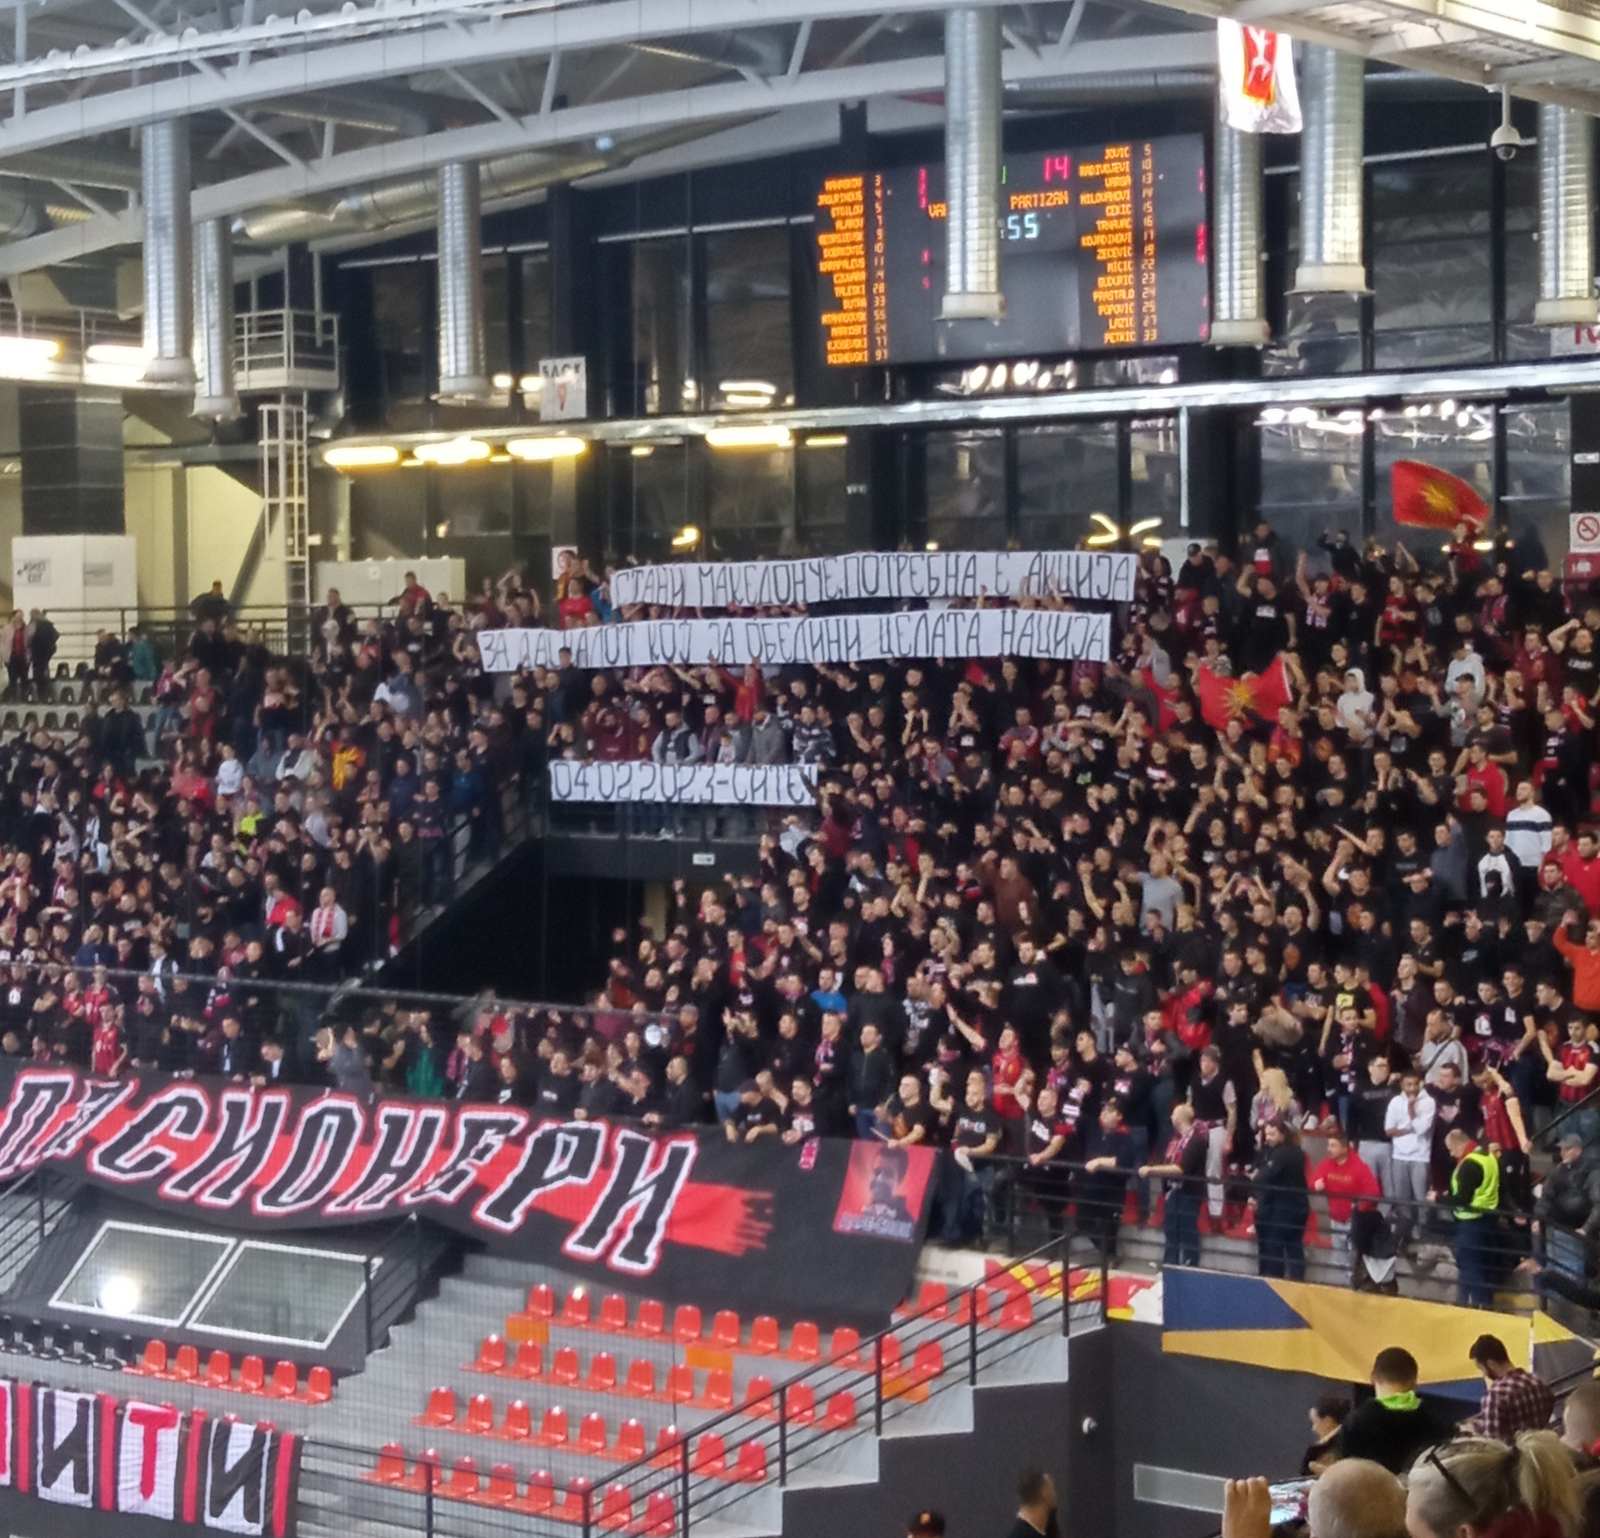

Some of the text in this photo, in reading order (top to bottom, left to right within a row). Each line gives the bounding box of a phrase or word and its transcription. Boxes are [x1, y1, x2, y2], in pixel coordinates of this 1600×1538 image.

[1044, 156, 1070, 182] 14
[1010, 191, 1070, 210] PARTIZAN
[616, 567, 685, 607] СТАНИ
[995, 553, 1010, 594] Е
[1027, 552, 1130, 600] АКЦИЈА
[482, 632, 509, 668] ЗА
[648, 621, 692, 664] КОЈ
[709, 622, 735, 664] ЈА
[746, 618, 861, 663] ОБЕДИНИ
[879, 612, 981, 658] ЦЕЛАТА
[1001, 609, 1105, 662] НАЦИЈА
[0, 1384, 273, 1523] ИТИ
